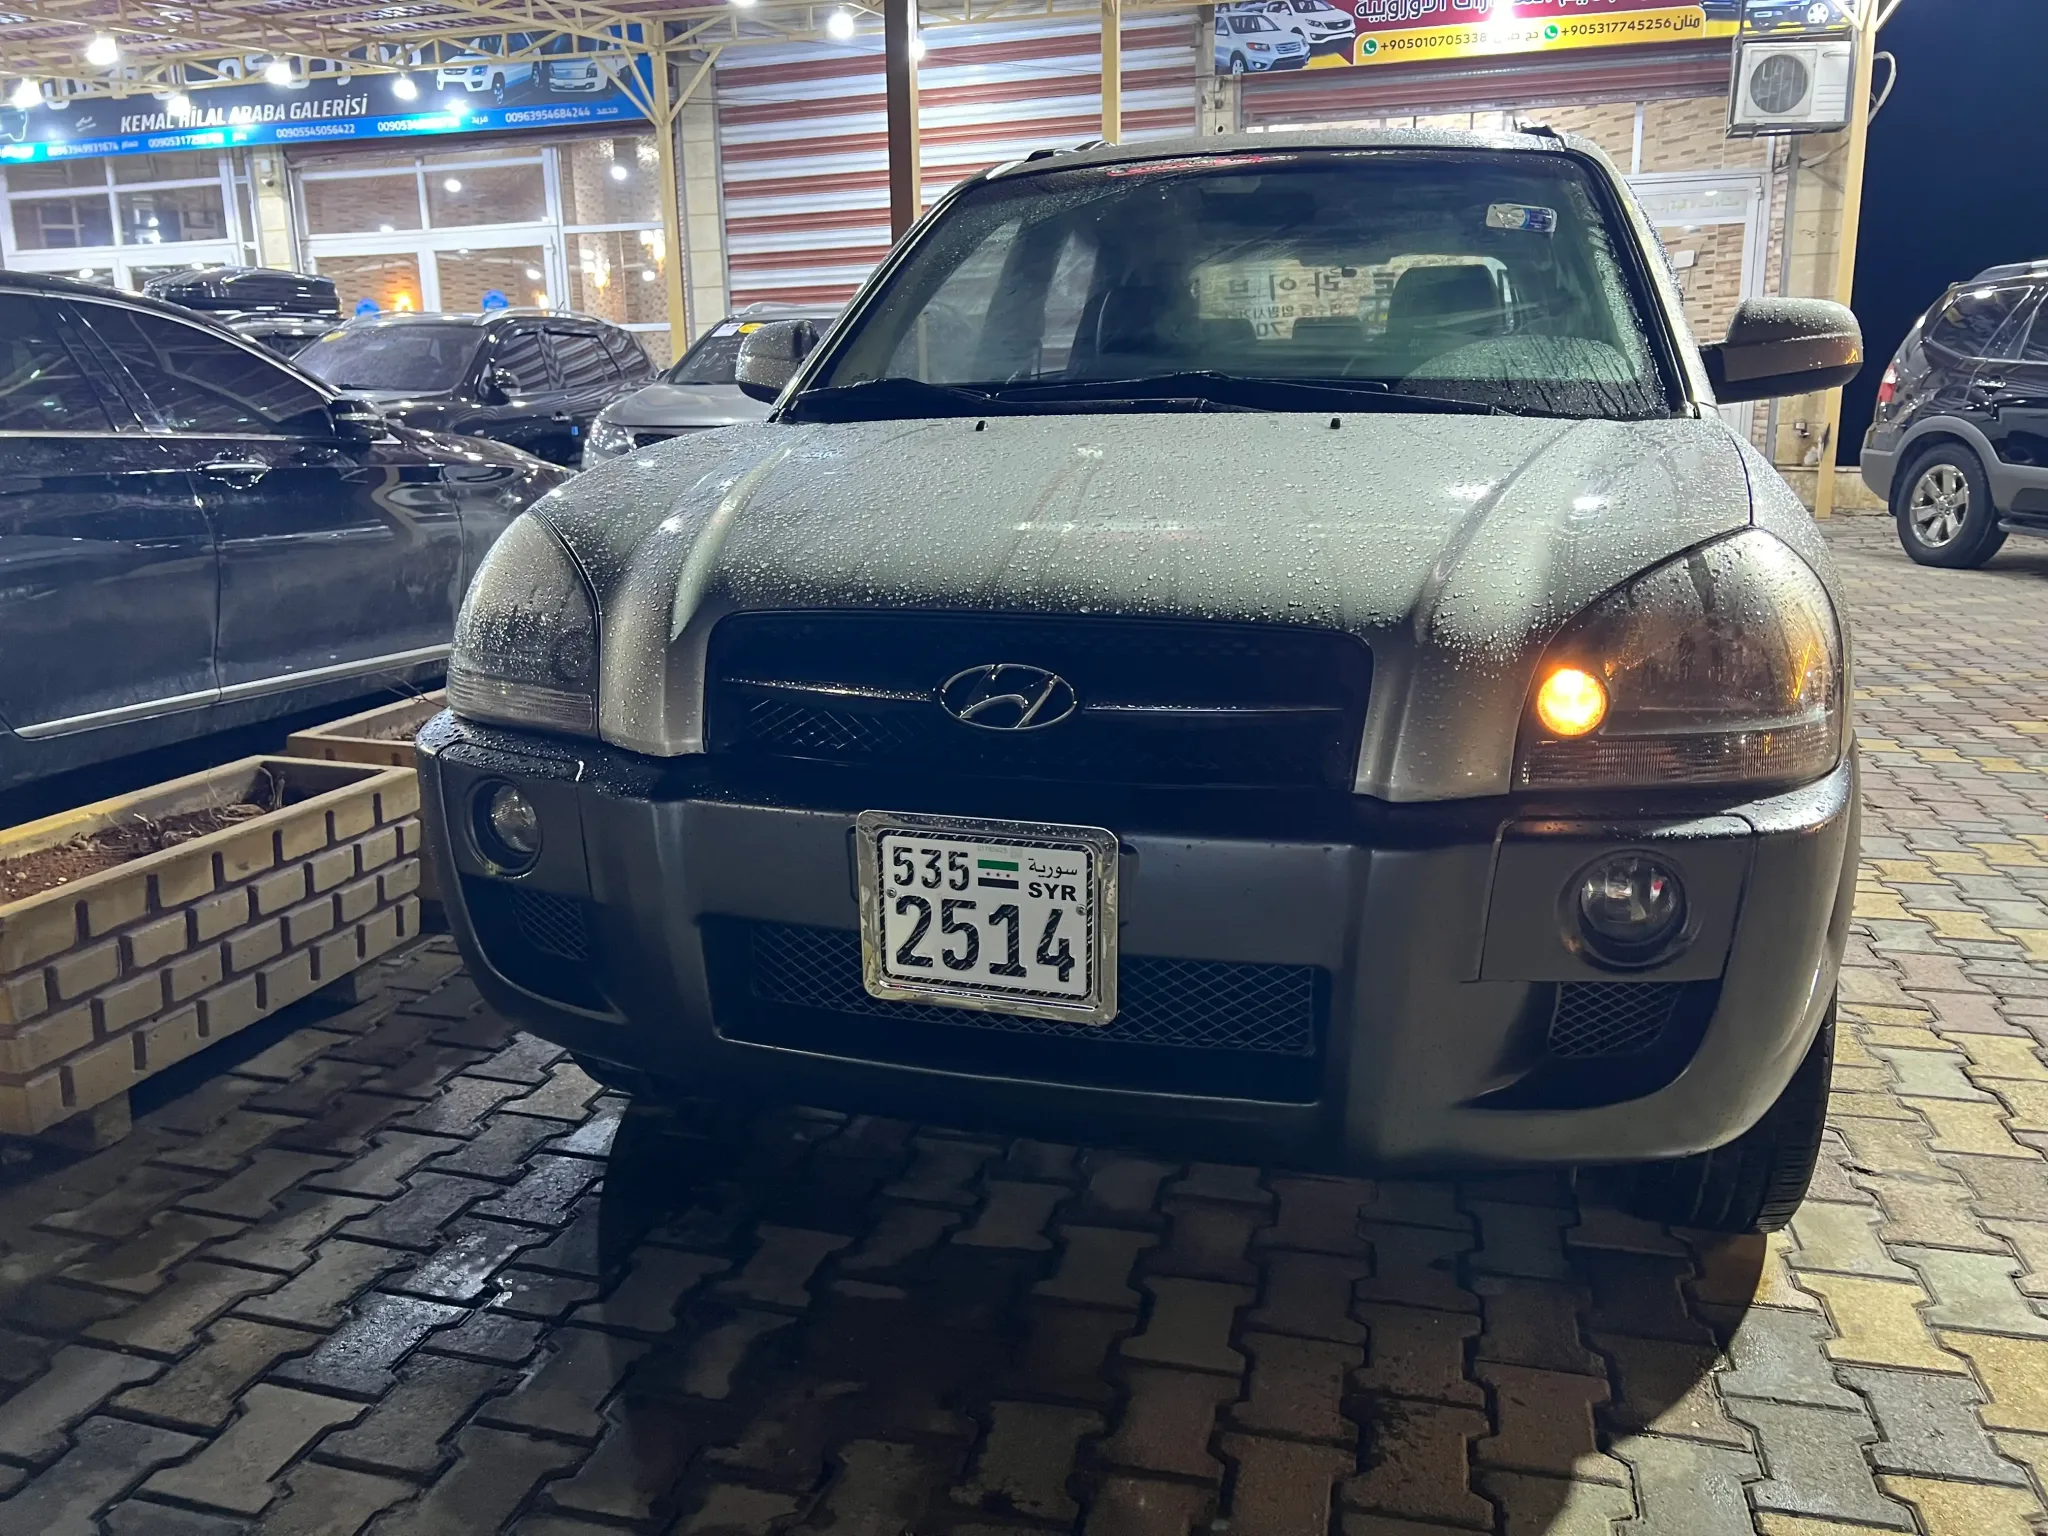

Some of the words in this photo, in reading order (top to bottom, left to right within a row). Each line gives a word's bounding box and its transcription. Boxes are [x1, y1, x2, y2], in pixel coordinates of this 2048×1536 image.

[1561, 17, 1672, 36] +905317745256
[1380, 32, 1487, 52] +905010705338
[120, 112, 175, 134] KEMAL
[290, 93, 368, 120] GALERİSİ
[505, 107, 591, 123] 00963954684244
[893, 846, 970, 891] 535
[1028, 857, 1078, 879] سورية
[1028, 882, 1077, 902] SYR
[895, 894, 1076, 983] 2514
